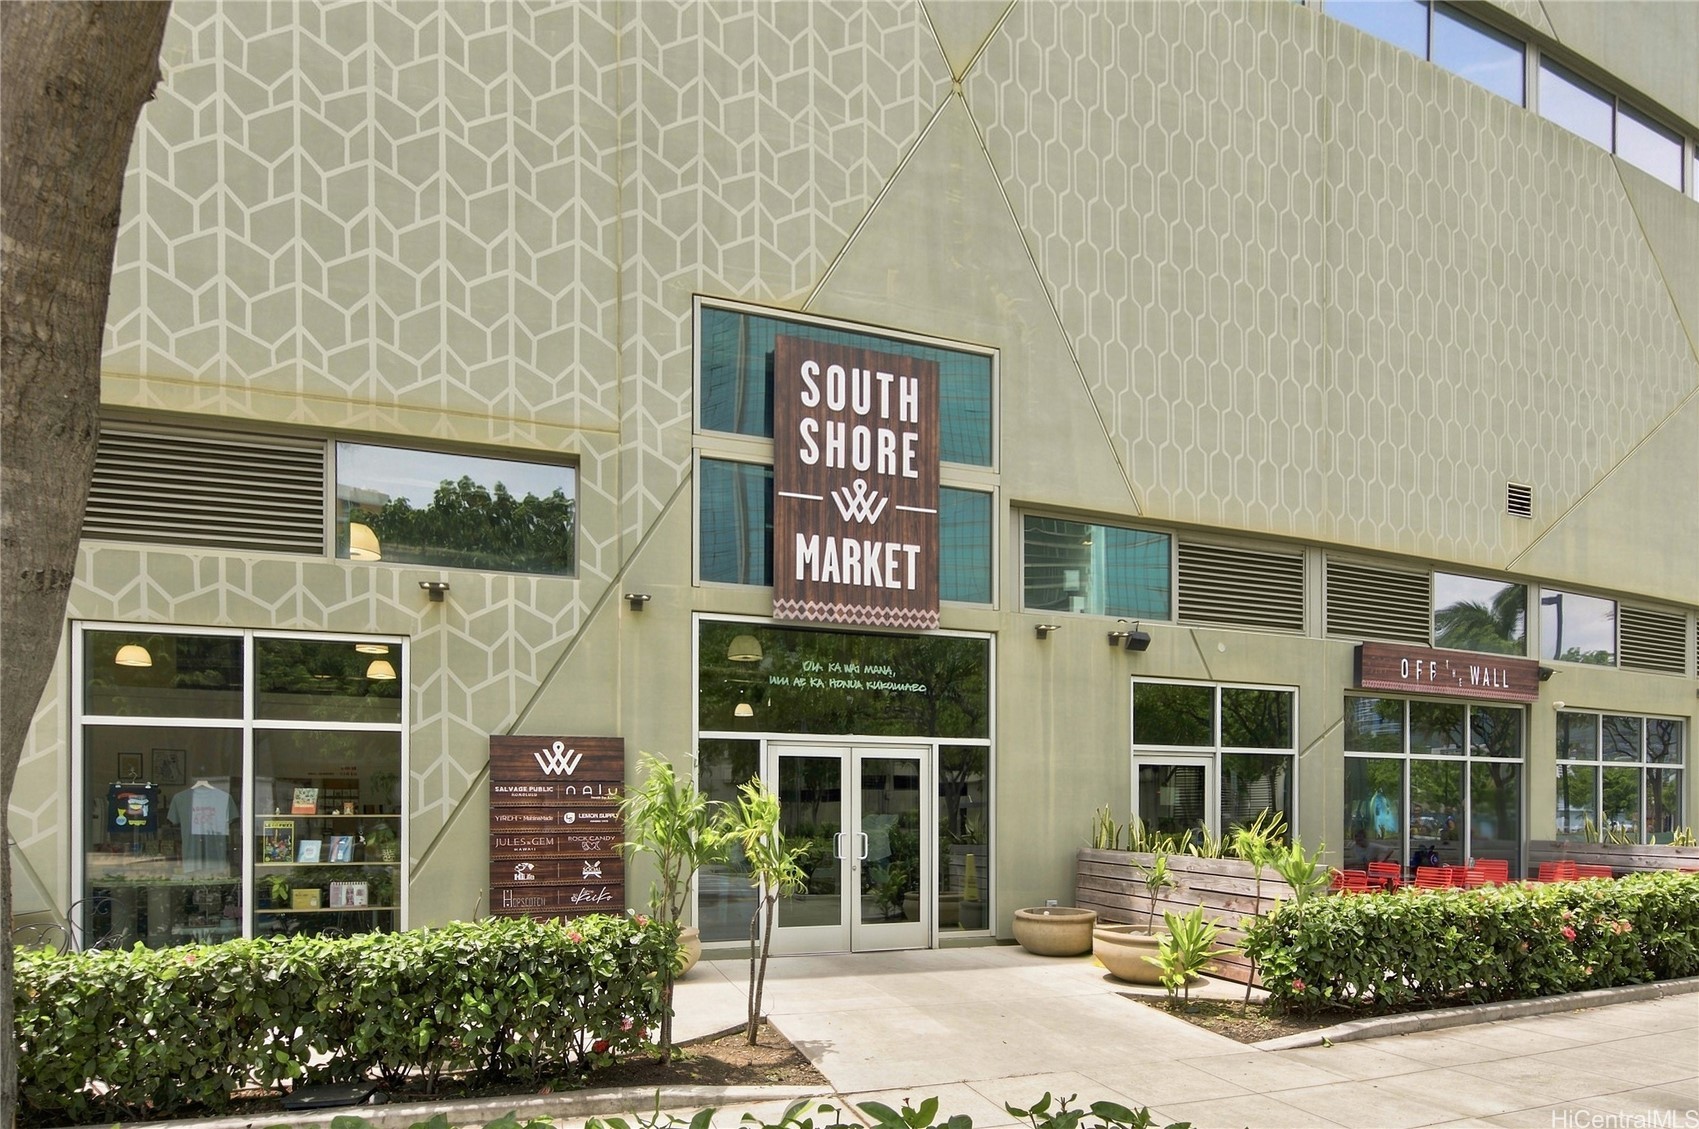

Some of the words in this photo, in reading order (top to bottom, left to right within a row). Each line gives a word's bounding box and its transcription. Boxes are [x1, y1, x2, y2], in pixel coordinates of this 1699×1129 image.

[800, 360, 919, 423] SOUTH
[799, 417, 919, 479] SHORE
[795, 533, 921, 590] MARKET
[810, 677, 825, 689] KA
[829, 678, 864, 690] HONUA
[828, 662, 842, 674] KA
[863, 664, 896, 678] MANA,
[1401, 658, 1437, 682] OFF
[1470, 665, 1510, 688] WALL
[495, 837, 526, 848] JULES
[531, 837, 554, 846] GEM
